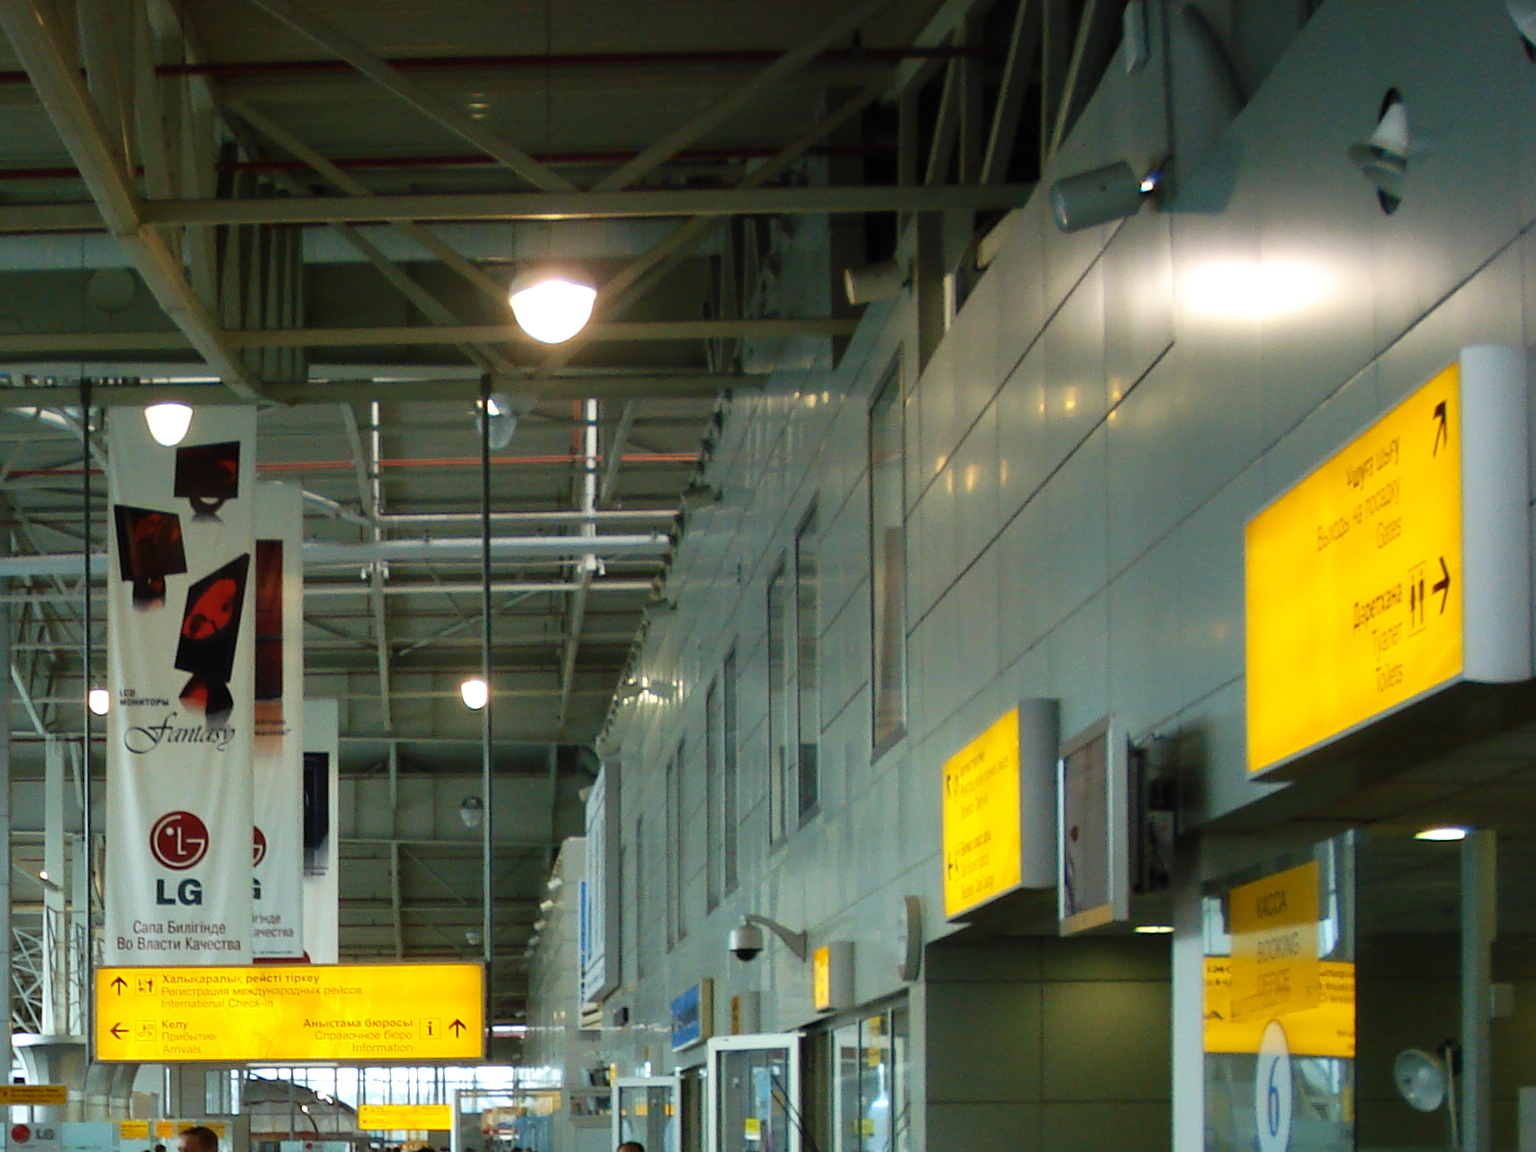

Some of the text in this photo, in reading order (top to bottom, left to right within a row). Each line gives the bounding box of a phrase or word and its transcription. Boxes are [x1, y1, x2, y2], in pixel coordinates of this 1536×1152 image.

[124, 711, 235, 754] Fantasy
[156, 878, 203, 906] LG
[133, 920, 163, 935] Сапа
[117, 937, 241, 950] Во Власти Качества
[352, 1043, 413, 1053] Information
[1267, 1055, 1280, 1137] 6
